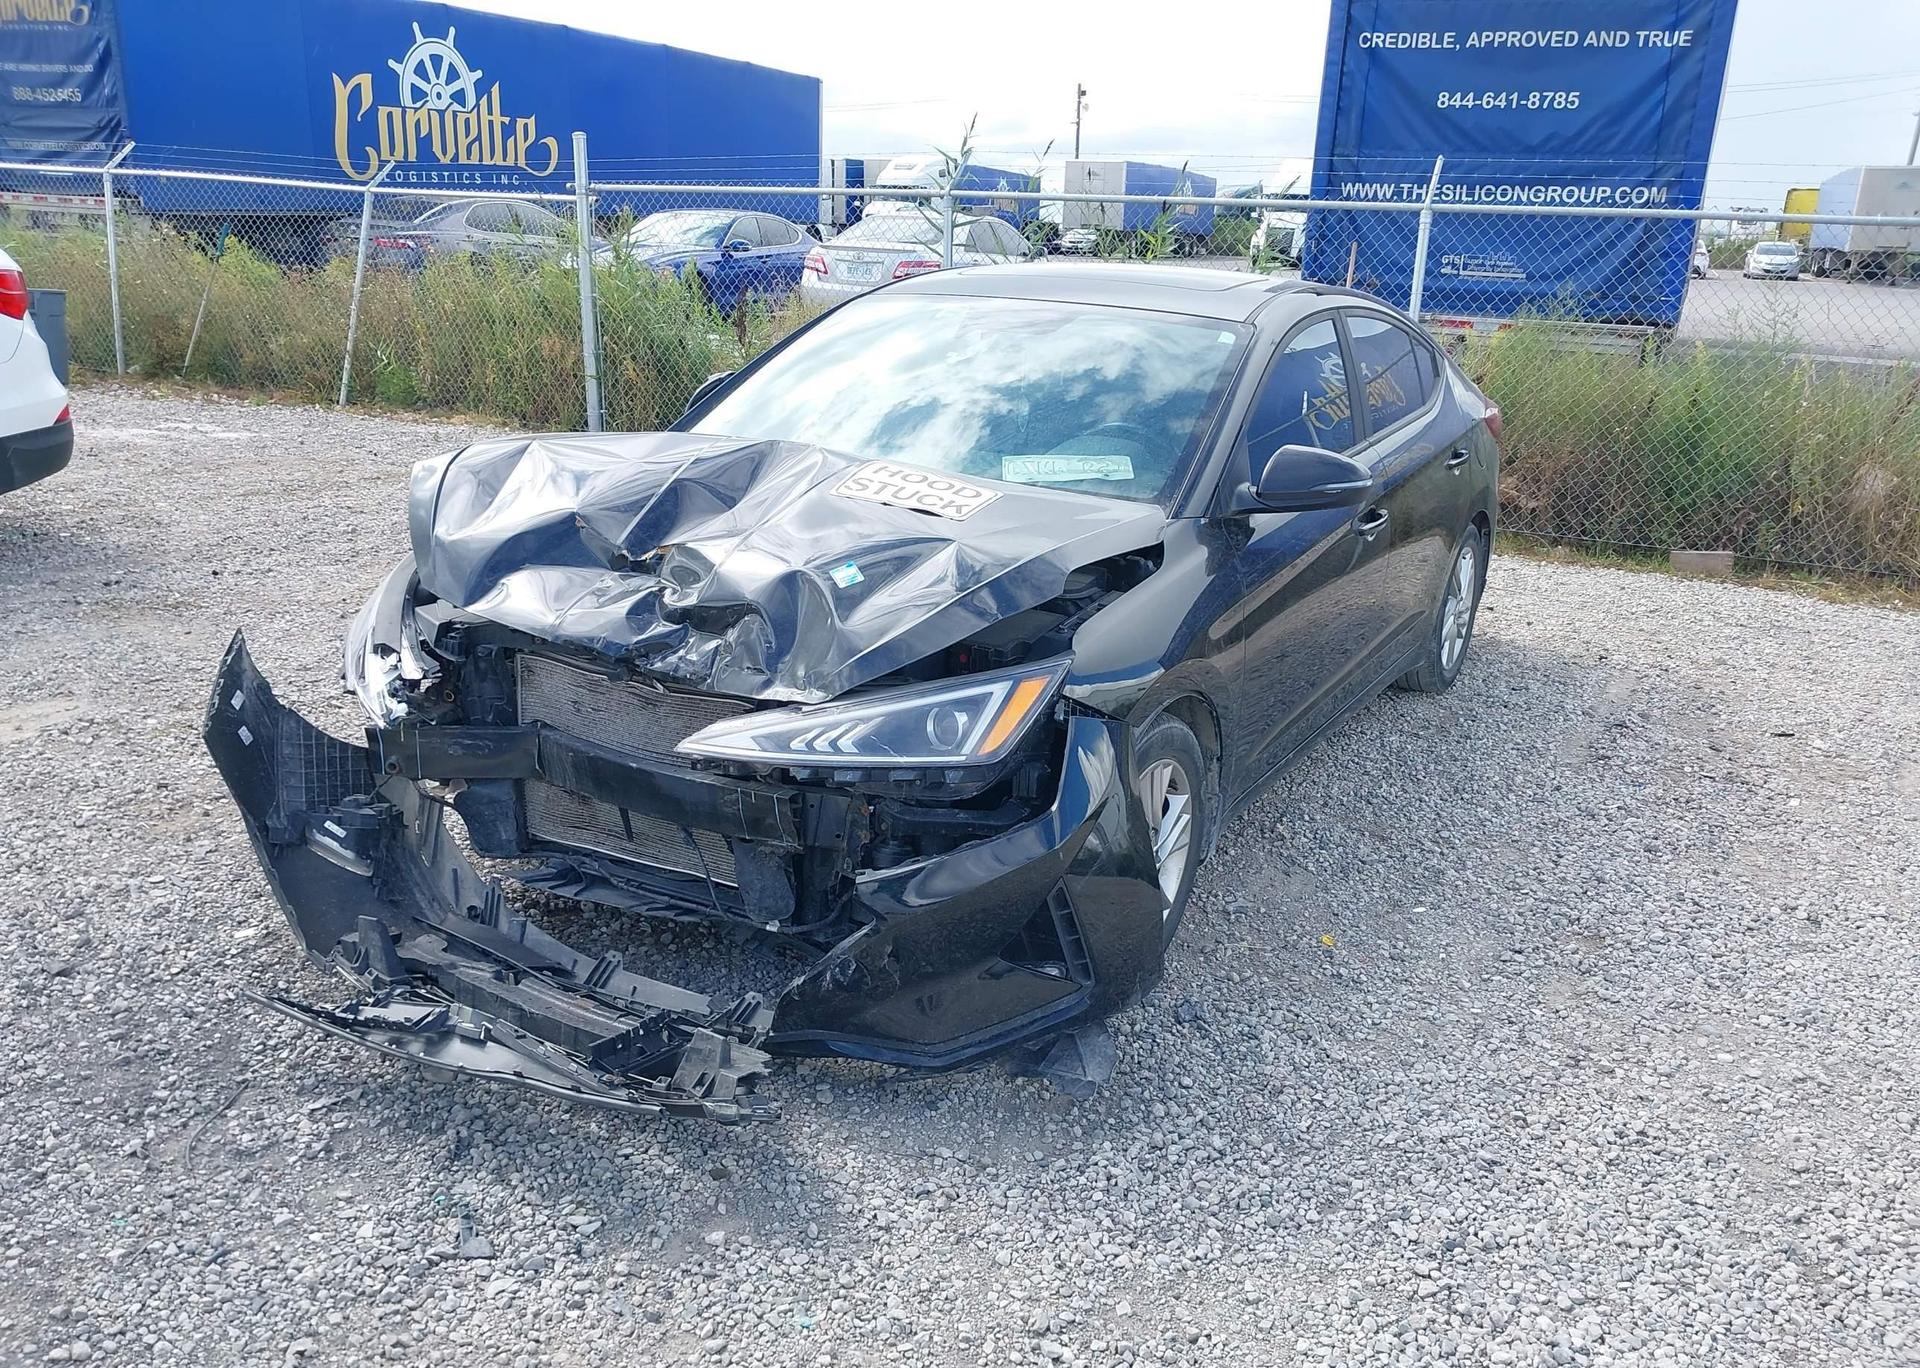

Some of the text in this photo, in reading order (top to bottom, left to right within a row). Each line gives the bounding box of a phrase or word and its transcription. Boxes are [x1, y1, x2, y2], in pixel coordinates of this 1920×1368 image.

[1358, 29, 1693, 51] CREDIBLE, APPROVED AND TRUE
[1436, 91, 1580, 109] 844-641-8785
[332, 72, 559, 181] Corvette
[384, 171, 528, 186] LOGISTICS INC.
[1341, 181, 1668, 204] WWW.THESILICONGROUP.COM
[872, 465, 983, 499] HOOD
[844, 477, 972, 515] STUCK
